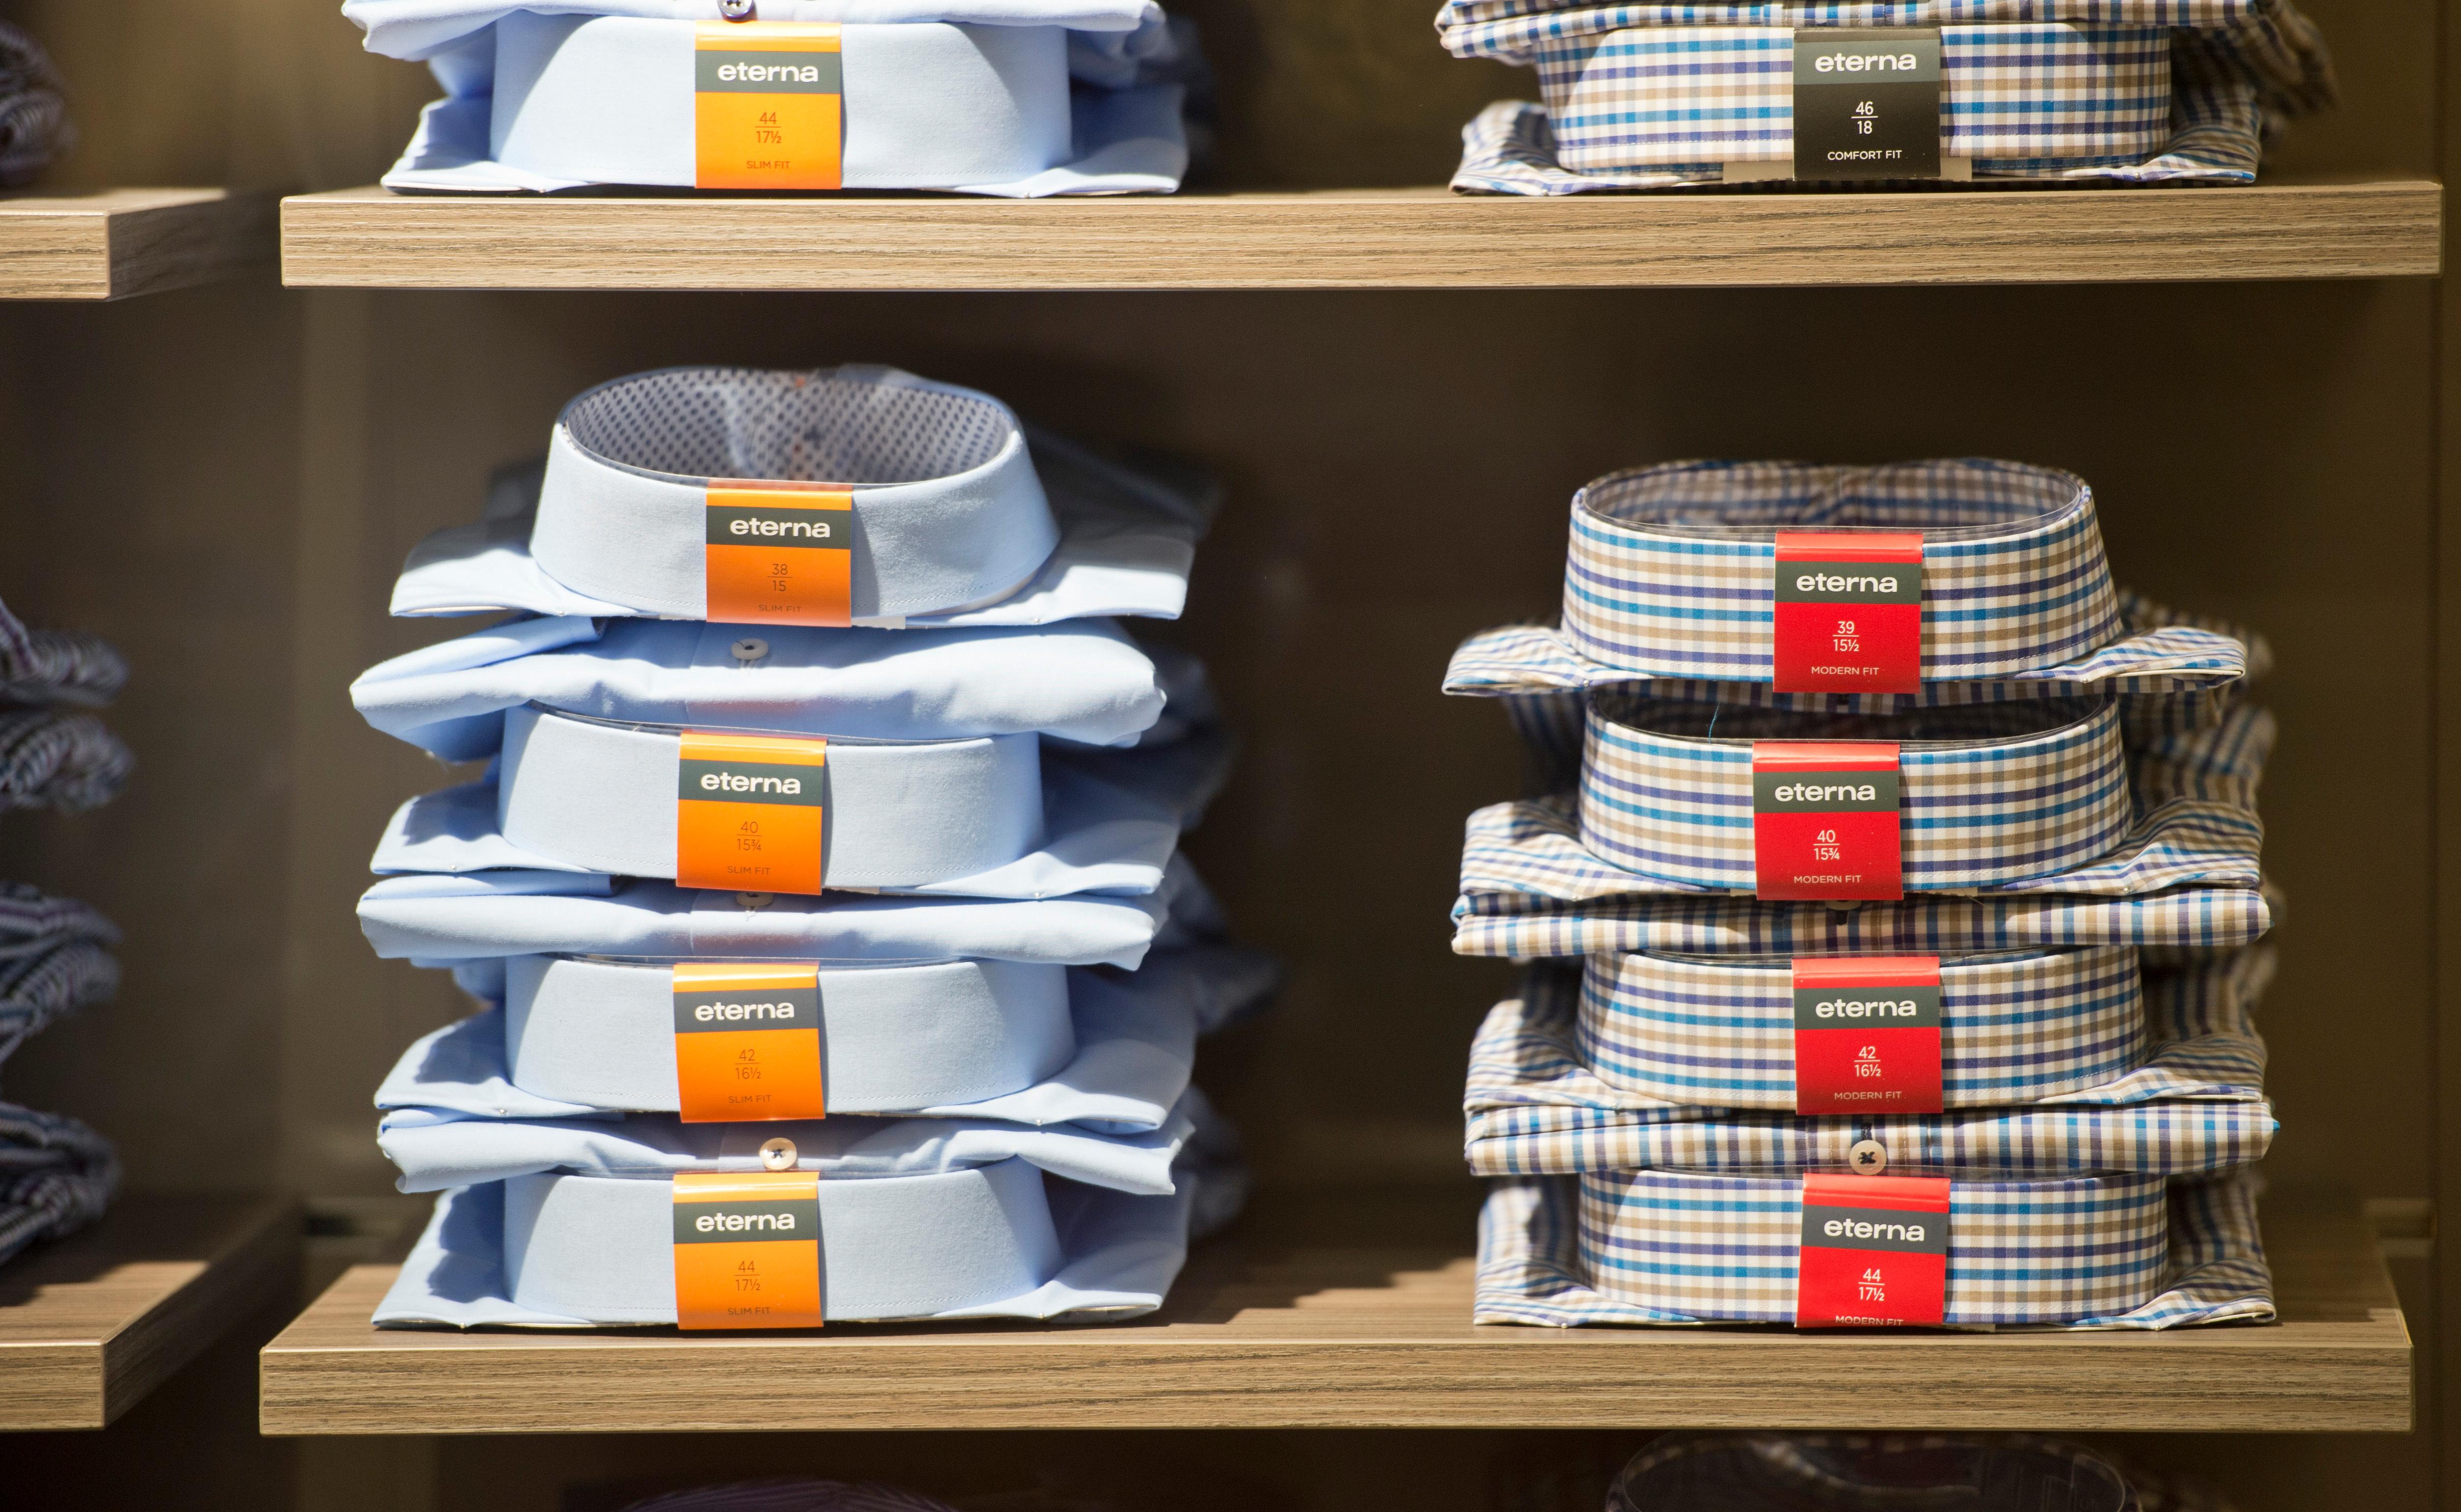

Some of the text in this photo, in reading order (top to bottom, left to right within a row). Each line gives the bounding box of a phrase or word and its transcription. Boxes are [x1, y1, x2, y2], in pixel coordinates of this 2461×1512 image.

[1815, 53, 1916, 72] eterna
[717, 62, 818, 82] eterna
[1856, 101, 1873, 115] 46
[759, 112, 778, 125] 44
[1857, 121, 1872, 134] 18
[1828, 150, 1902, 160] COMFORT FIT
[730, 518, 830, 538] eterna
[772, 564, 788, 575] 38
[772, 580, 786, 592] 15
[1796, 573, 1897, 593] eterna
[1838, 621, 1855, 634] 39
[1811, 666, 1859, 675] MODERN
[701, 772, 800, 794] eterna
[1775, 783, 1875, 801] eterna
[740, 821, 758, 833] 40
[1817, 830, 1835, 843] 40
[695, 1002, 794, 1021] eterna
[1815, 999, 1916, 1018] eterna
[739, 1049, 755, 1061] 42
[1858, 1046, 1875, 1059] 42
[696, 1213, 795, 1232] eterna
[1824, 1218, 1924, 1241] eterna
[738, 1261, 755, 1273] 44
[1863, 1268, 1881, 1281] 44
[1835, 1315, 1884, 1325] MODERN
